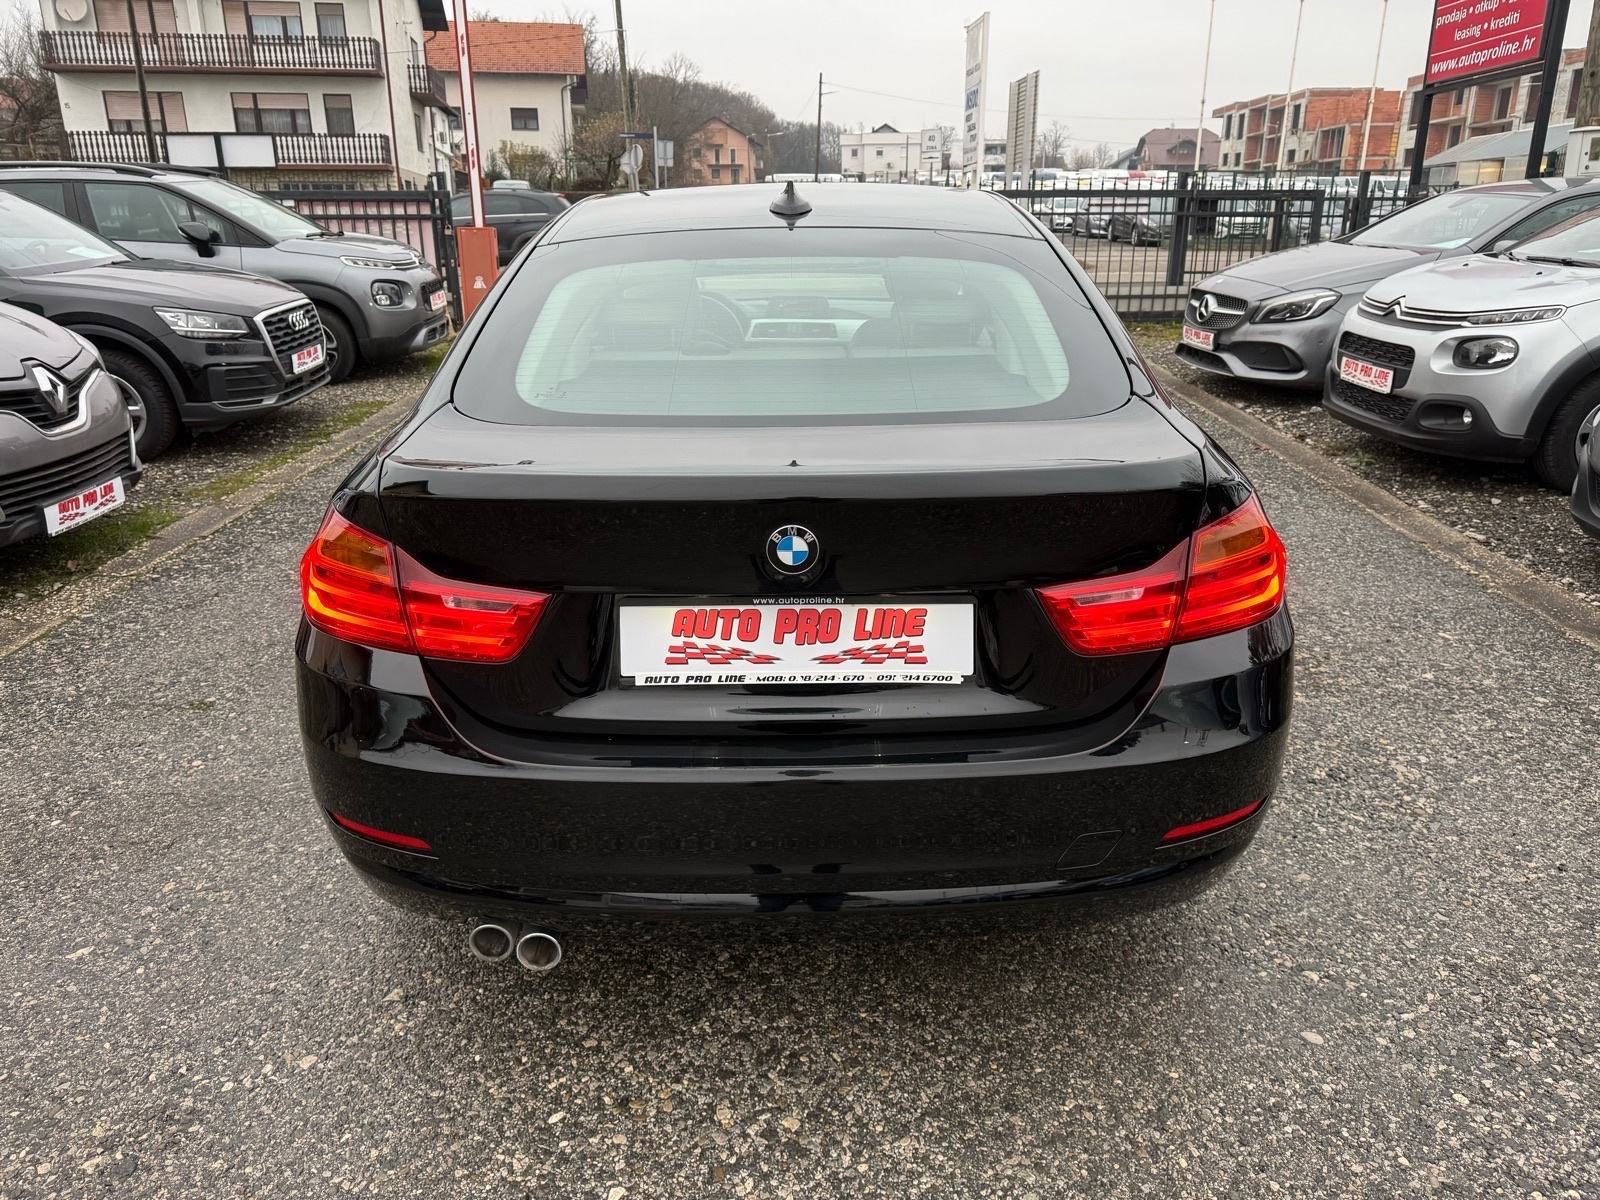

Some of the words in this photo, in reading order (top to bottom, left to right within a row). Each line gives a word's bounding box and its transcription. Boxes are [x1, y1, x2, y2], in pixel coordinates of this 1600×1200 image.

[1436, 7, 1467, 29] prodaja
[1475, 0, 1499, 14] otkup
[1454, 24, 1482, 41] leasing
[1490, 10, 1521, 31] krediti
[1431, 34, 1536, 74] www.autoproline.hr
[771, 527, 815, 544] BMW
[752, 597, 845, 605] www.autoproline.hr
[671, 608, 762, 642] AUTO
[773, 608, 842, 645] PRO
[853, 608, 928, 641] LINE
[644, 675, 680, 684] AUTO
[685, 675, 713, 684] PRO
[717, 674, 747, 683] LINE
[755, 675, 787, 683] MOB:
